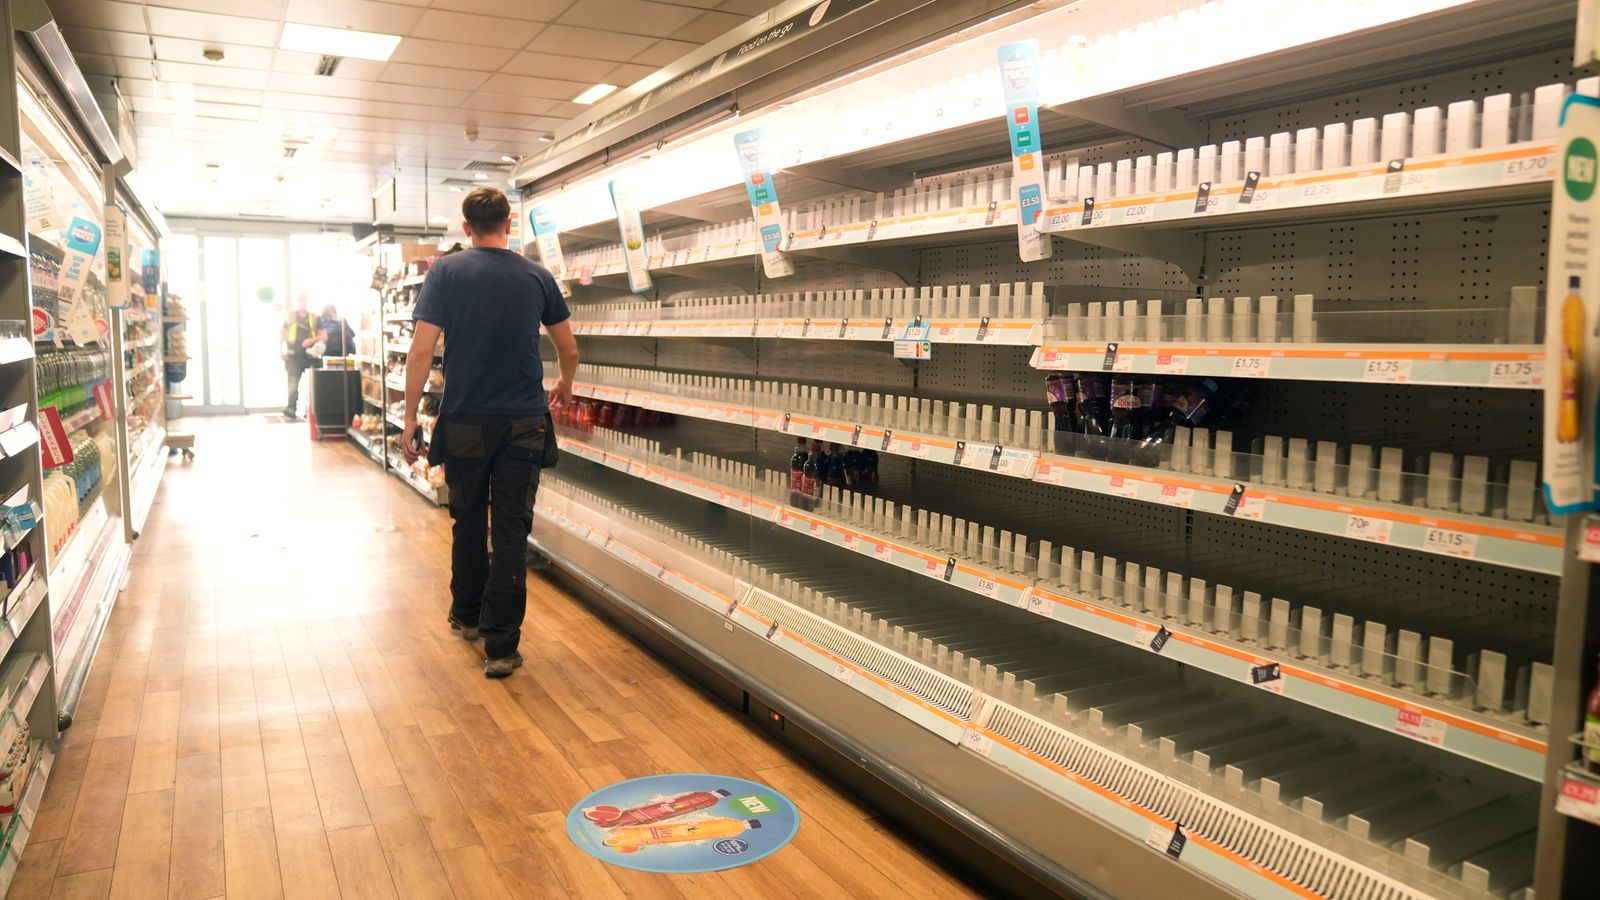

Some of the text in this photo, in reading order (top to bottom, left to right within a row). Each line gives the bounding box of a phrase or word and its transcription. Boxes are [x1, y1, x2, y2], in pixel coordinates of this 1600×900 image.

[737, 39, 761, 56] Food
[767, 28, 781, 41] the
[780, 22, 794, 39] go
[1507, 156, 1547, 175] £1.70
[1303, 184, 1332, 197] £2.75
[1022, 196, 1040, 208] £3.50
[1125, 206, 1147, 217] £2.00
[1051, 215, 1070, 225] £2.00
[1235, 358, 1260, 368] £1.75
[1368, 361, 1399, 372] £1.75
[1494, 363, 1532, 375] £1.75
[1428, 529, 1463, 546] £1.15
[978, 578, 994, 591] £1.80
[738, 796, 771, 814] NEW
